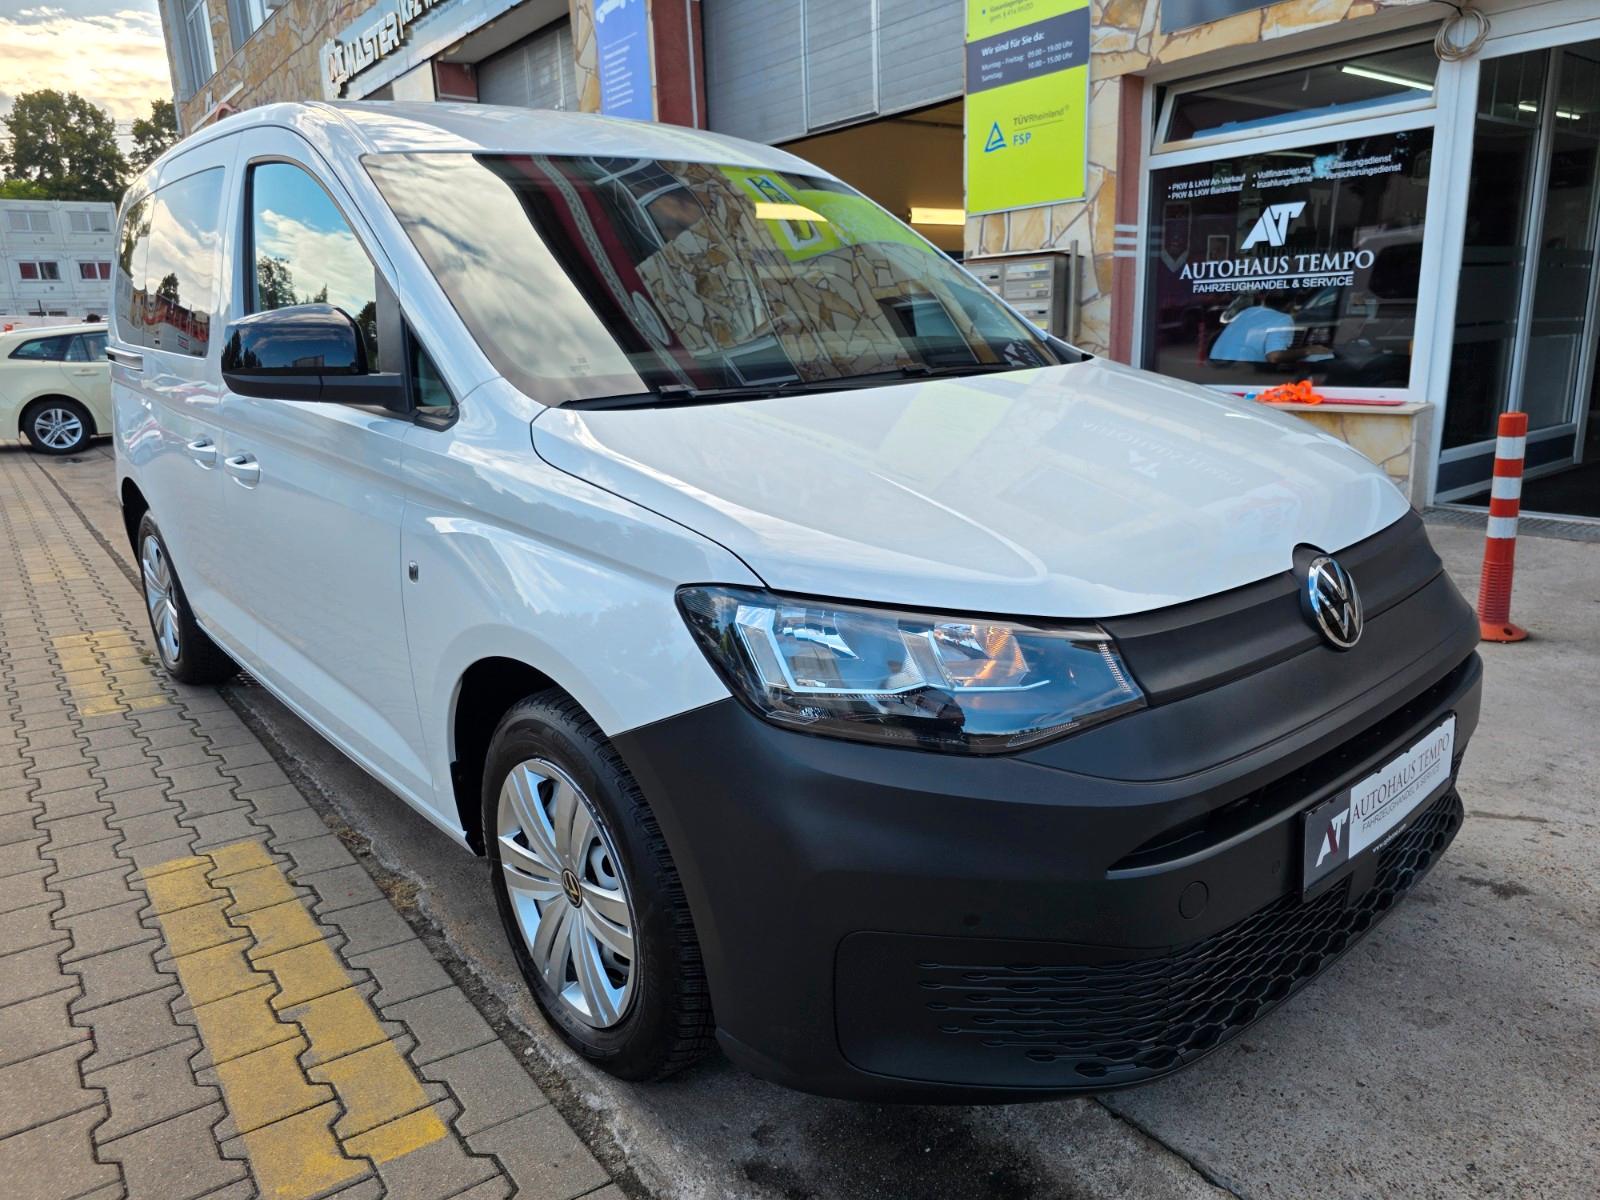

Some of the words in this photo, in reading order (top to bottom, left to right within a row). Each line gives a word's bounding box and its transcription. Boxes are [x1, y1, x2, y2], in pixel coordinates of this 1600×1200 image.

[344, 12, 400, 76] MASTER
[981, 46, 994, 57] Wir
[994, 41, 1010, 54] sind
[1010, 37, 1021, 49] für
[1021, 35, 1033, 46] Sie
[1033, 31, 1046, 42] da:
[1062, 40, 1074, 50] Uhr
[1062, 52, 1074, 61] Uhr
[1012, 132, 1032, 146] FSP
[1172, 182, 1188, 191] PKW
[1188, 181, 1194, 190] &
[1194, 179, 1210, 189] LKW
[1171, 190, 1187, 200] PKW
[1187, 189, 1194, 198] &
[1194, 187, 1210, 197] LKW
[1179, 256, 1289, 281] AUTOHAUS
[1294, 250, 1375, 273] TEMPO
[1192, 279, 1290, 293] FAHRZEUGHANDEL
[1292, 279, 1300, 289] &
[1302, 275, 1354, 288] SERVICE
[1351, 759, 1417, 825] AUTOHAUS
[1418, 732, 1450, 772] TEMPO
